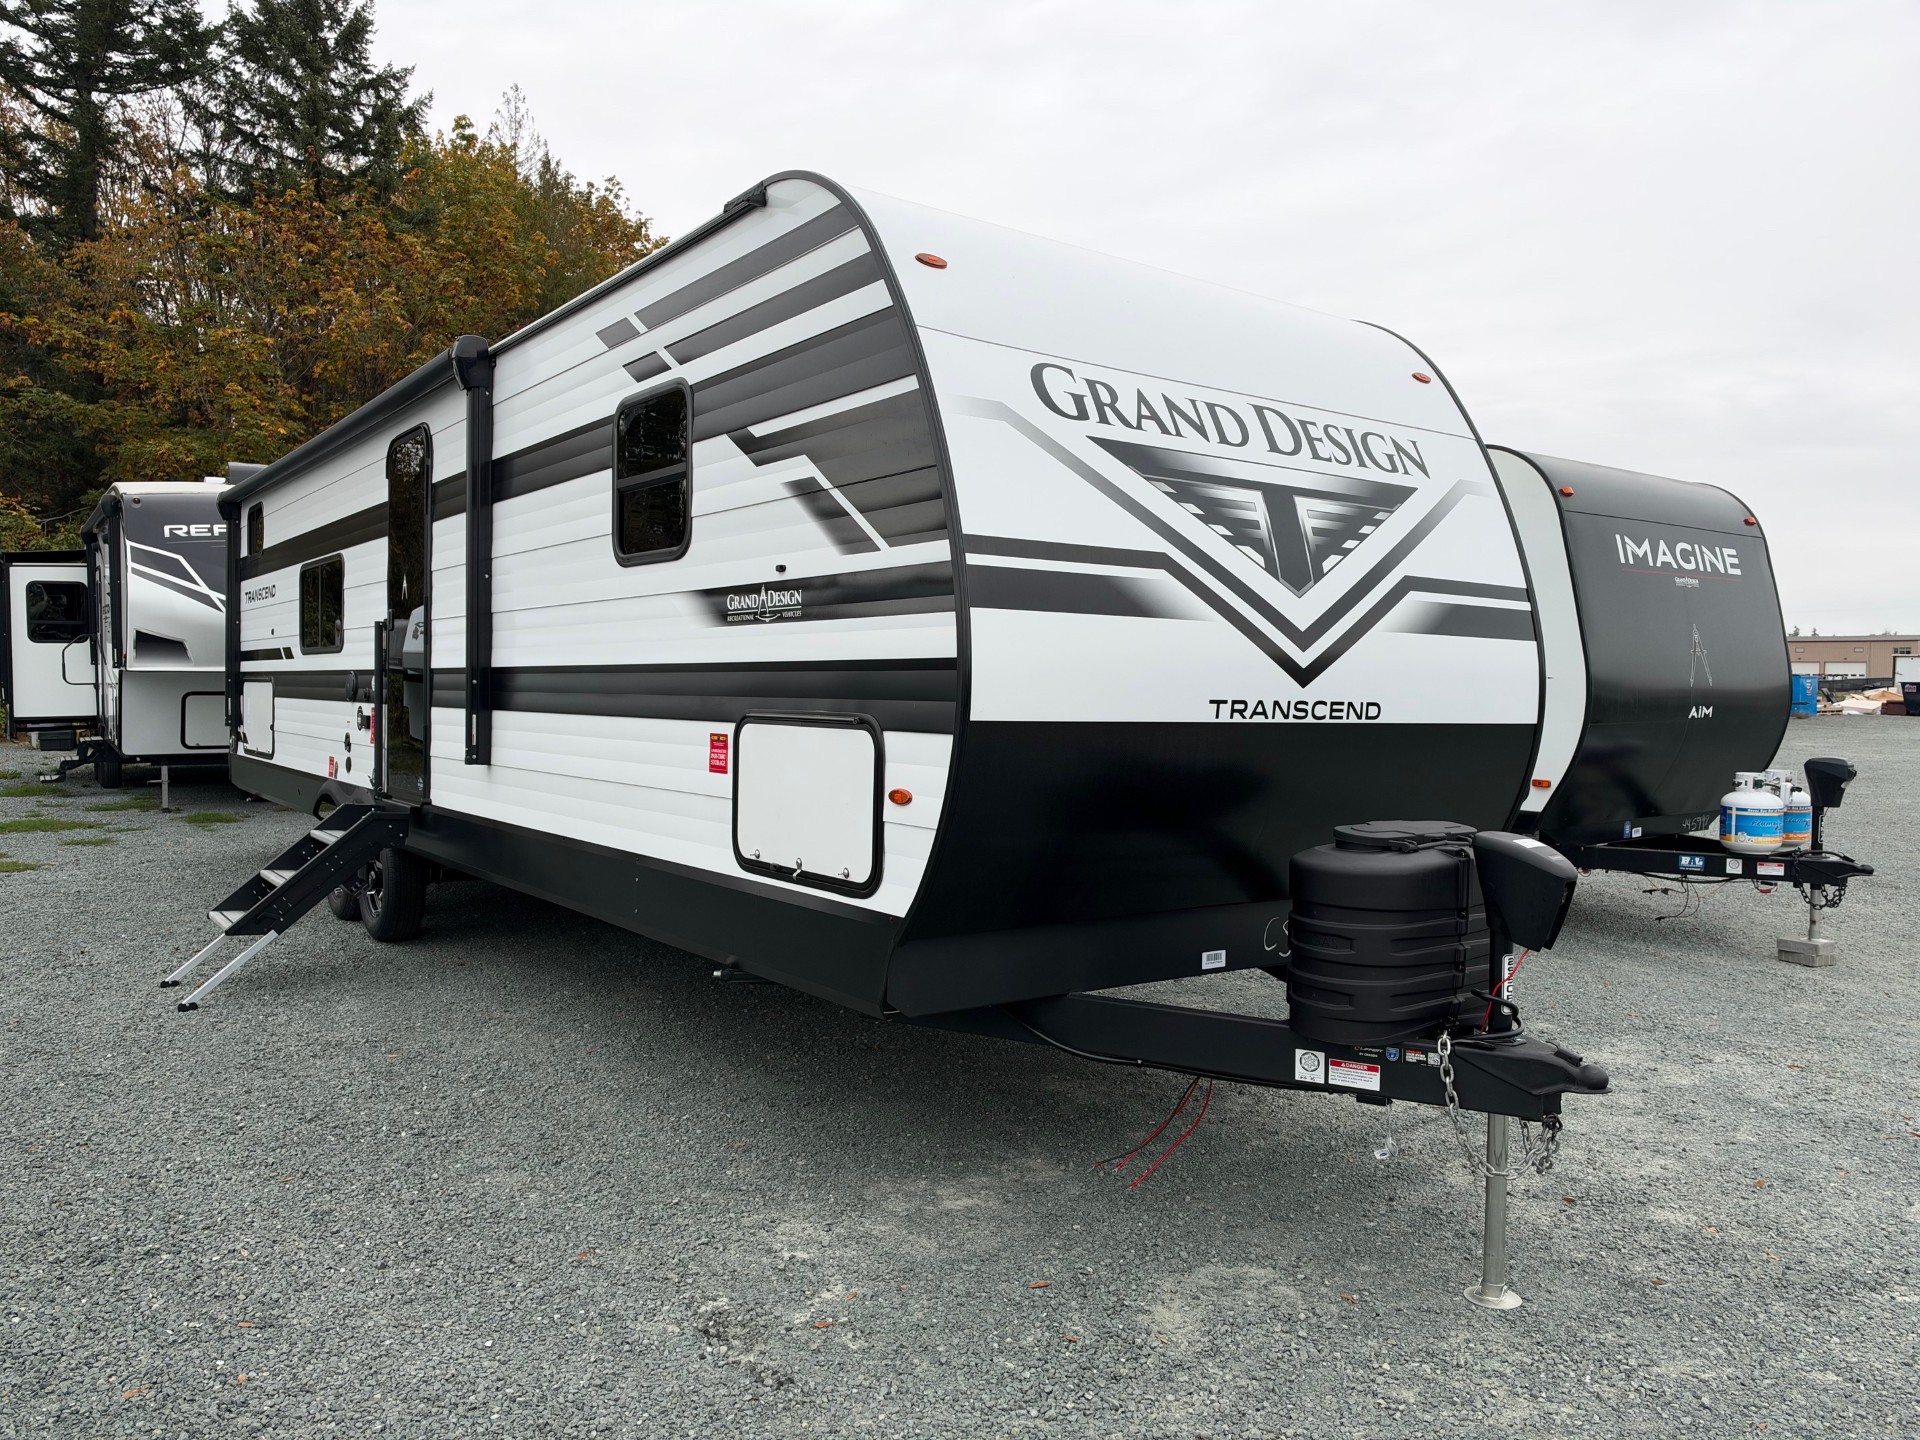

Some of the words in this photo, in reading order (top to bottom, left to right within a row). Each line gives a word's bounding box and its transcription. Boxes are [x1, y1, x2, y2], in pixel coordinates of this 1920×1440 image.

[1030, 363, 1250, 448] GRAND
[1246, 402, 1431, 480] DESIGN
[1615, 533, 1742, 576] IMAGINE
[245, 584, 276, 604] TRANSCEND
[727, 594, 759, 610] GRAND
[767, 589, 802, 606] DESIGN
[1209, 699, 1382, 720] TRANSCEND
[1345, 1063, 1368, 1071] DANGER
